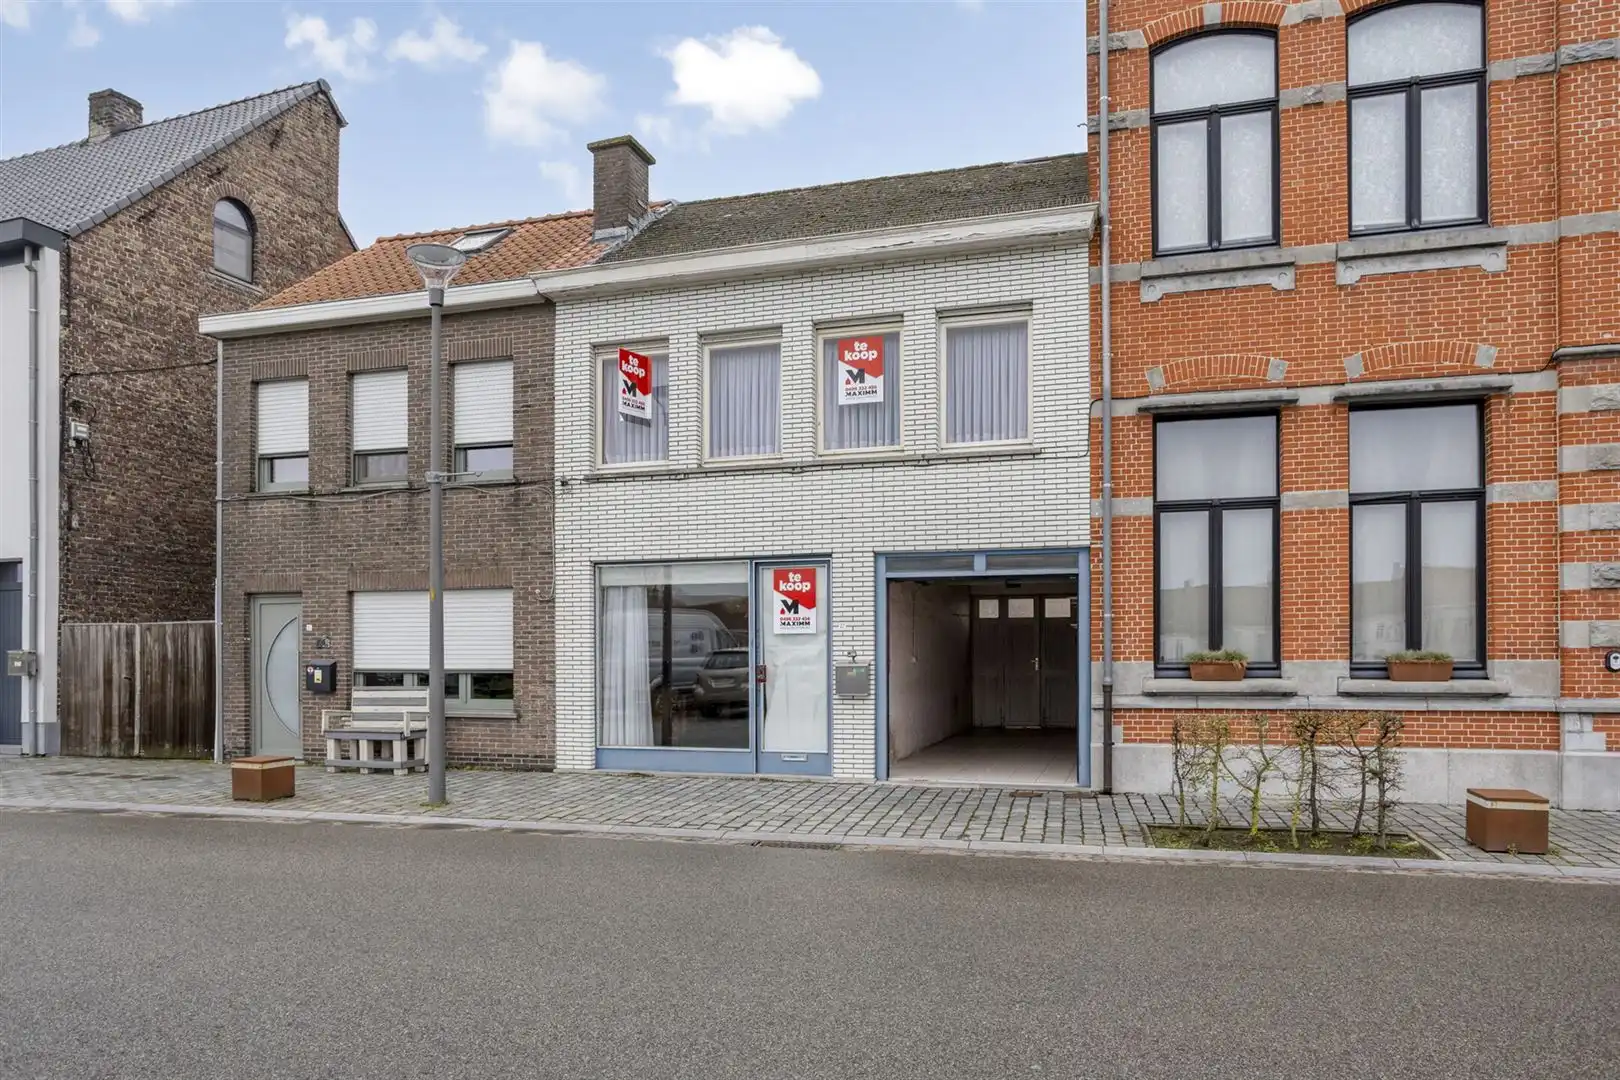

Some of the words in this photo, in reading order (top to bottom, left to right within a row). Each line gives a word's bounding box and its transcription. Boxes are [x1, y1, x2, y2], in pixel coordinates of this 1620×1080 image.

[854, 341, 868, 351] te
[628, 355, 639, 367] te
[844, 350, 878, 361] koop
[621, 360, 646, 378] koop
[844, 389, 878, 397] MAXIMM
[788, 572, 802, 582] te
[779, 580, 811, 593] koop
